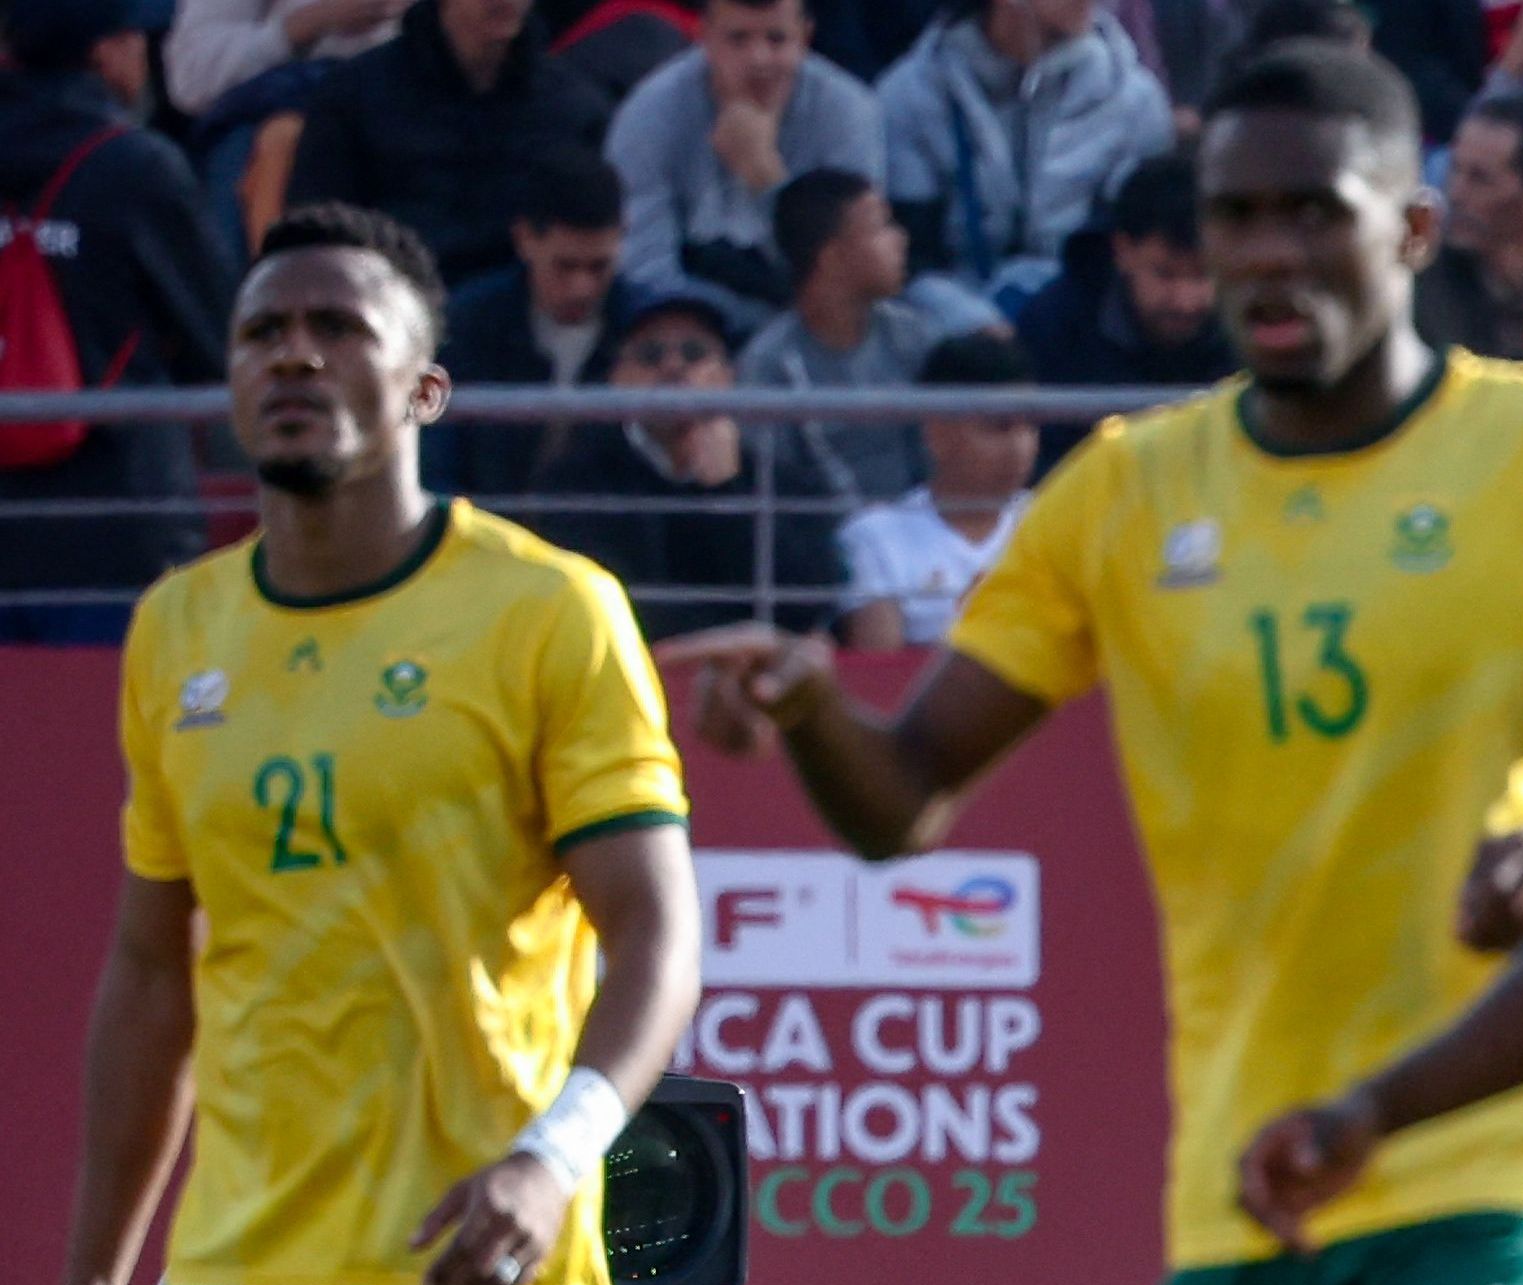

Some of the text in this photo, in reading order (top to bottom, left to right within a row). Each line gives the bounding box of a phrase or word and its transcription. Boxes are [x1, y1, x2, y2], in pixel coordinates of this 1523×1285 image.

[1250, 602, 1370, 745] 13
[252, 752, 349, 873] 21
[851, 991, 1042, 1076] CUP
[747, 1083, 1042, 1164] ATIONS
[755, 1167, 1039, 1240] CCO 25
